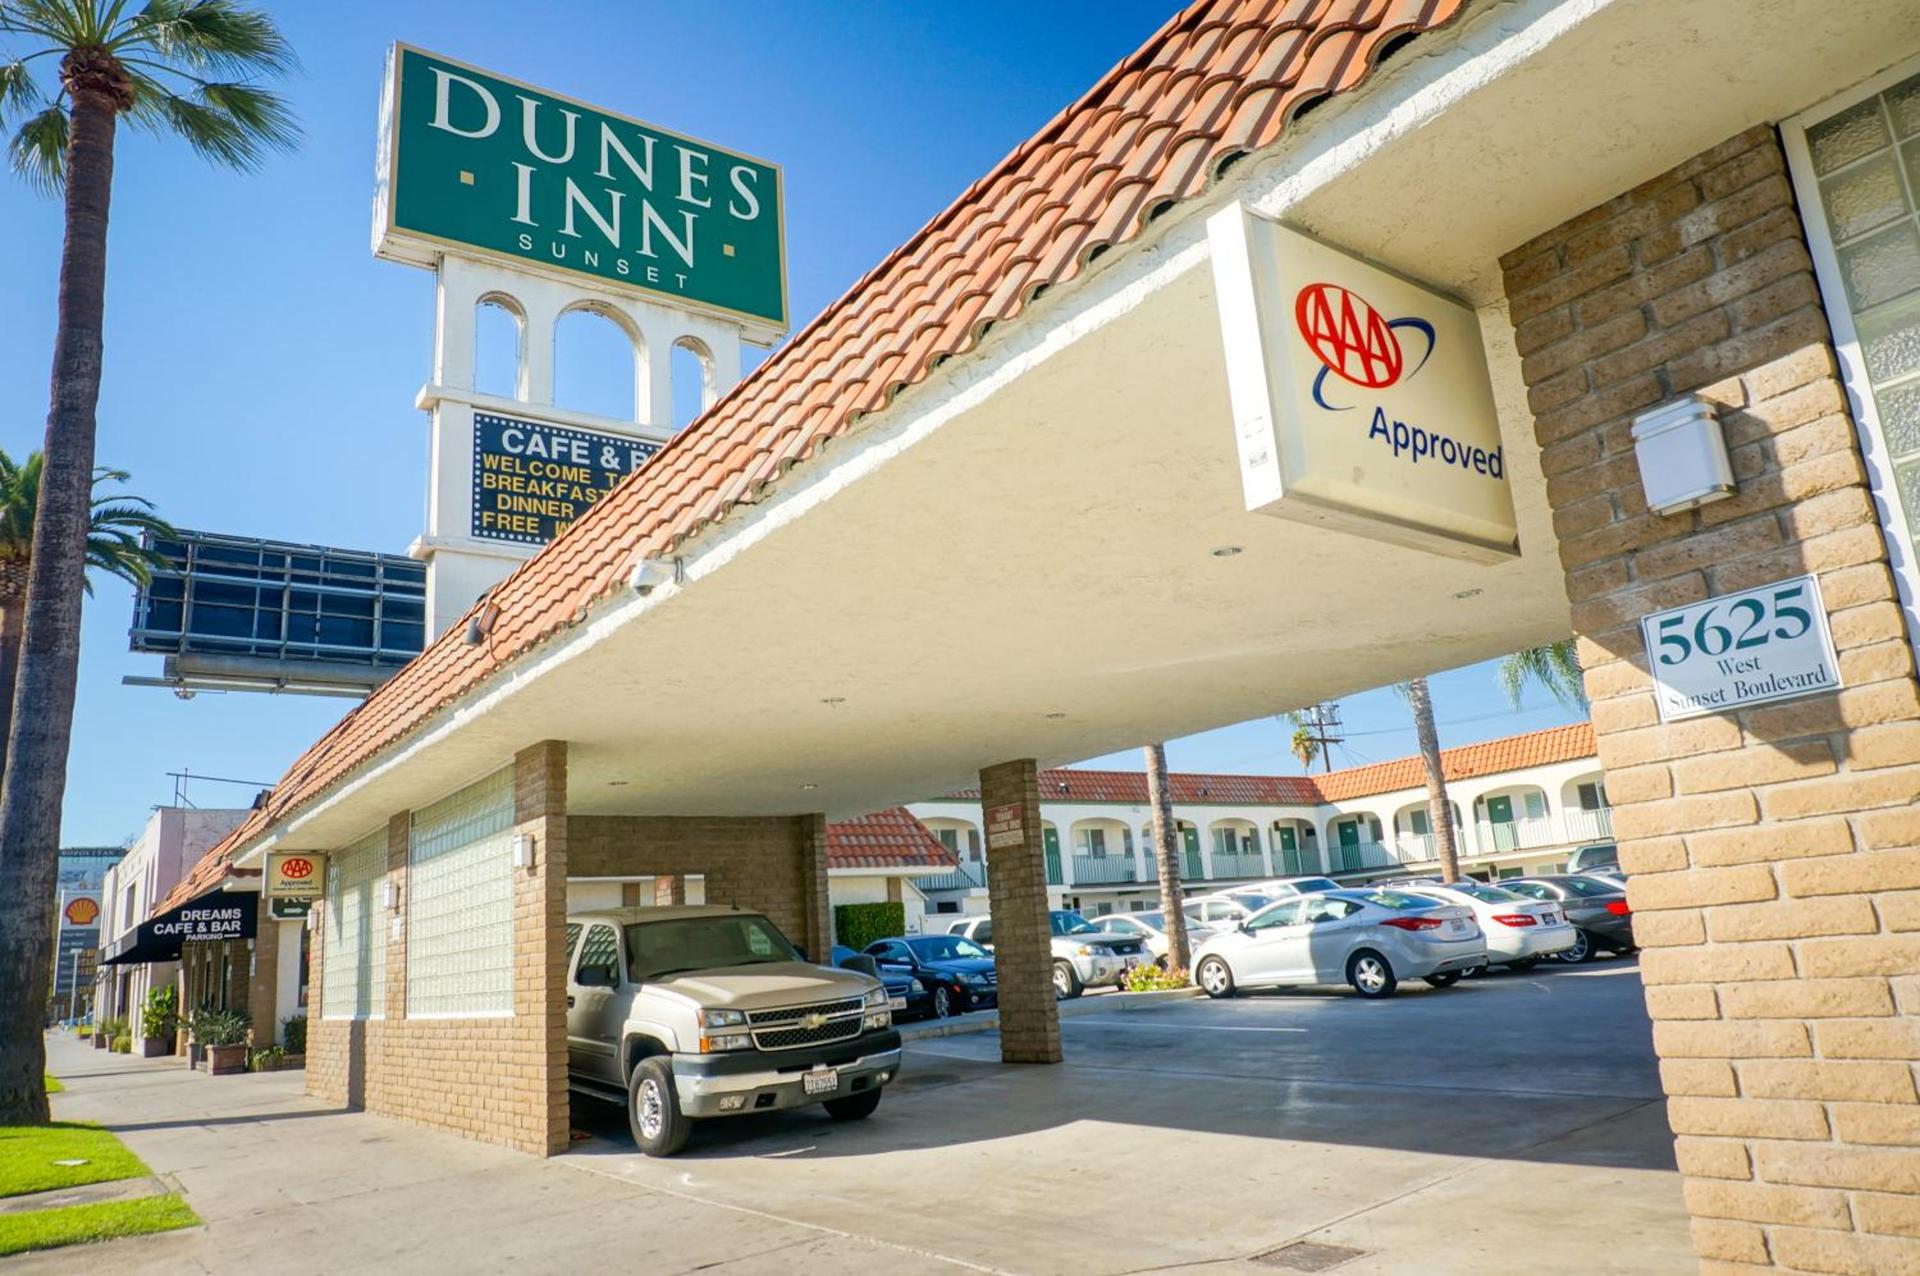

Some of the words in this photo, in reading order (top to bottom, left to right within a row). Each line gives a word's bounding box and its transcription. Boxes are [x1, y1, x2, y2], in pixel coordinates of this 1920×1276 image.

[427, 66, 760, 221] DUNES
[510, 161, 699, 269] INN
[518, 233, 687, 289] SUNSET
[1296, 283, 1403, 388] AAA
[501, 428, 591, 465] CAFE
[600, 445, 621, 470] &
[1368, 405, 1503, 480] Approved
[483, 452, 592, 485] WELCOME
[481, 511, 540, 535] FREE
[497, 493, 575, 519] DINNER
[1659, 583, 1812, 666] 5625
[1716, 654, 1762, 677] West
[1668, 687, 1727, 711] Sunset
[1734, 663, 1828, 700] Boulevard
[281, 858, 313, 879] AAA
[153, 922, 194, 935] CAFE
[196, 921, 207, 933] &
[210, 920, 242, 932] BAR
[181, 907, 242, 921] DREAMS
[185, 932, 224, 942] PARKING
